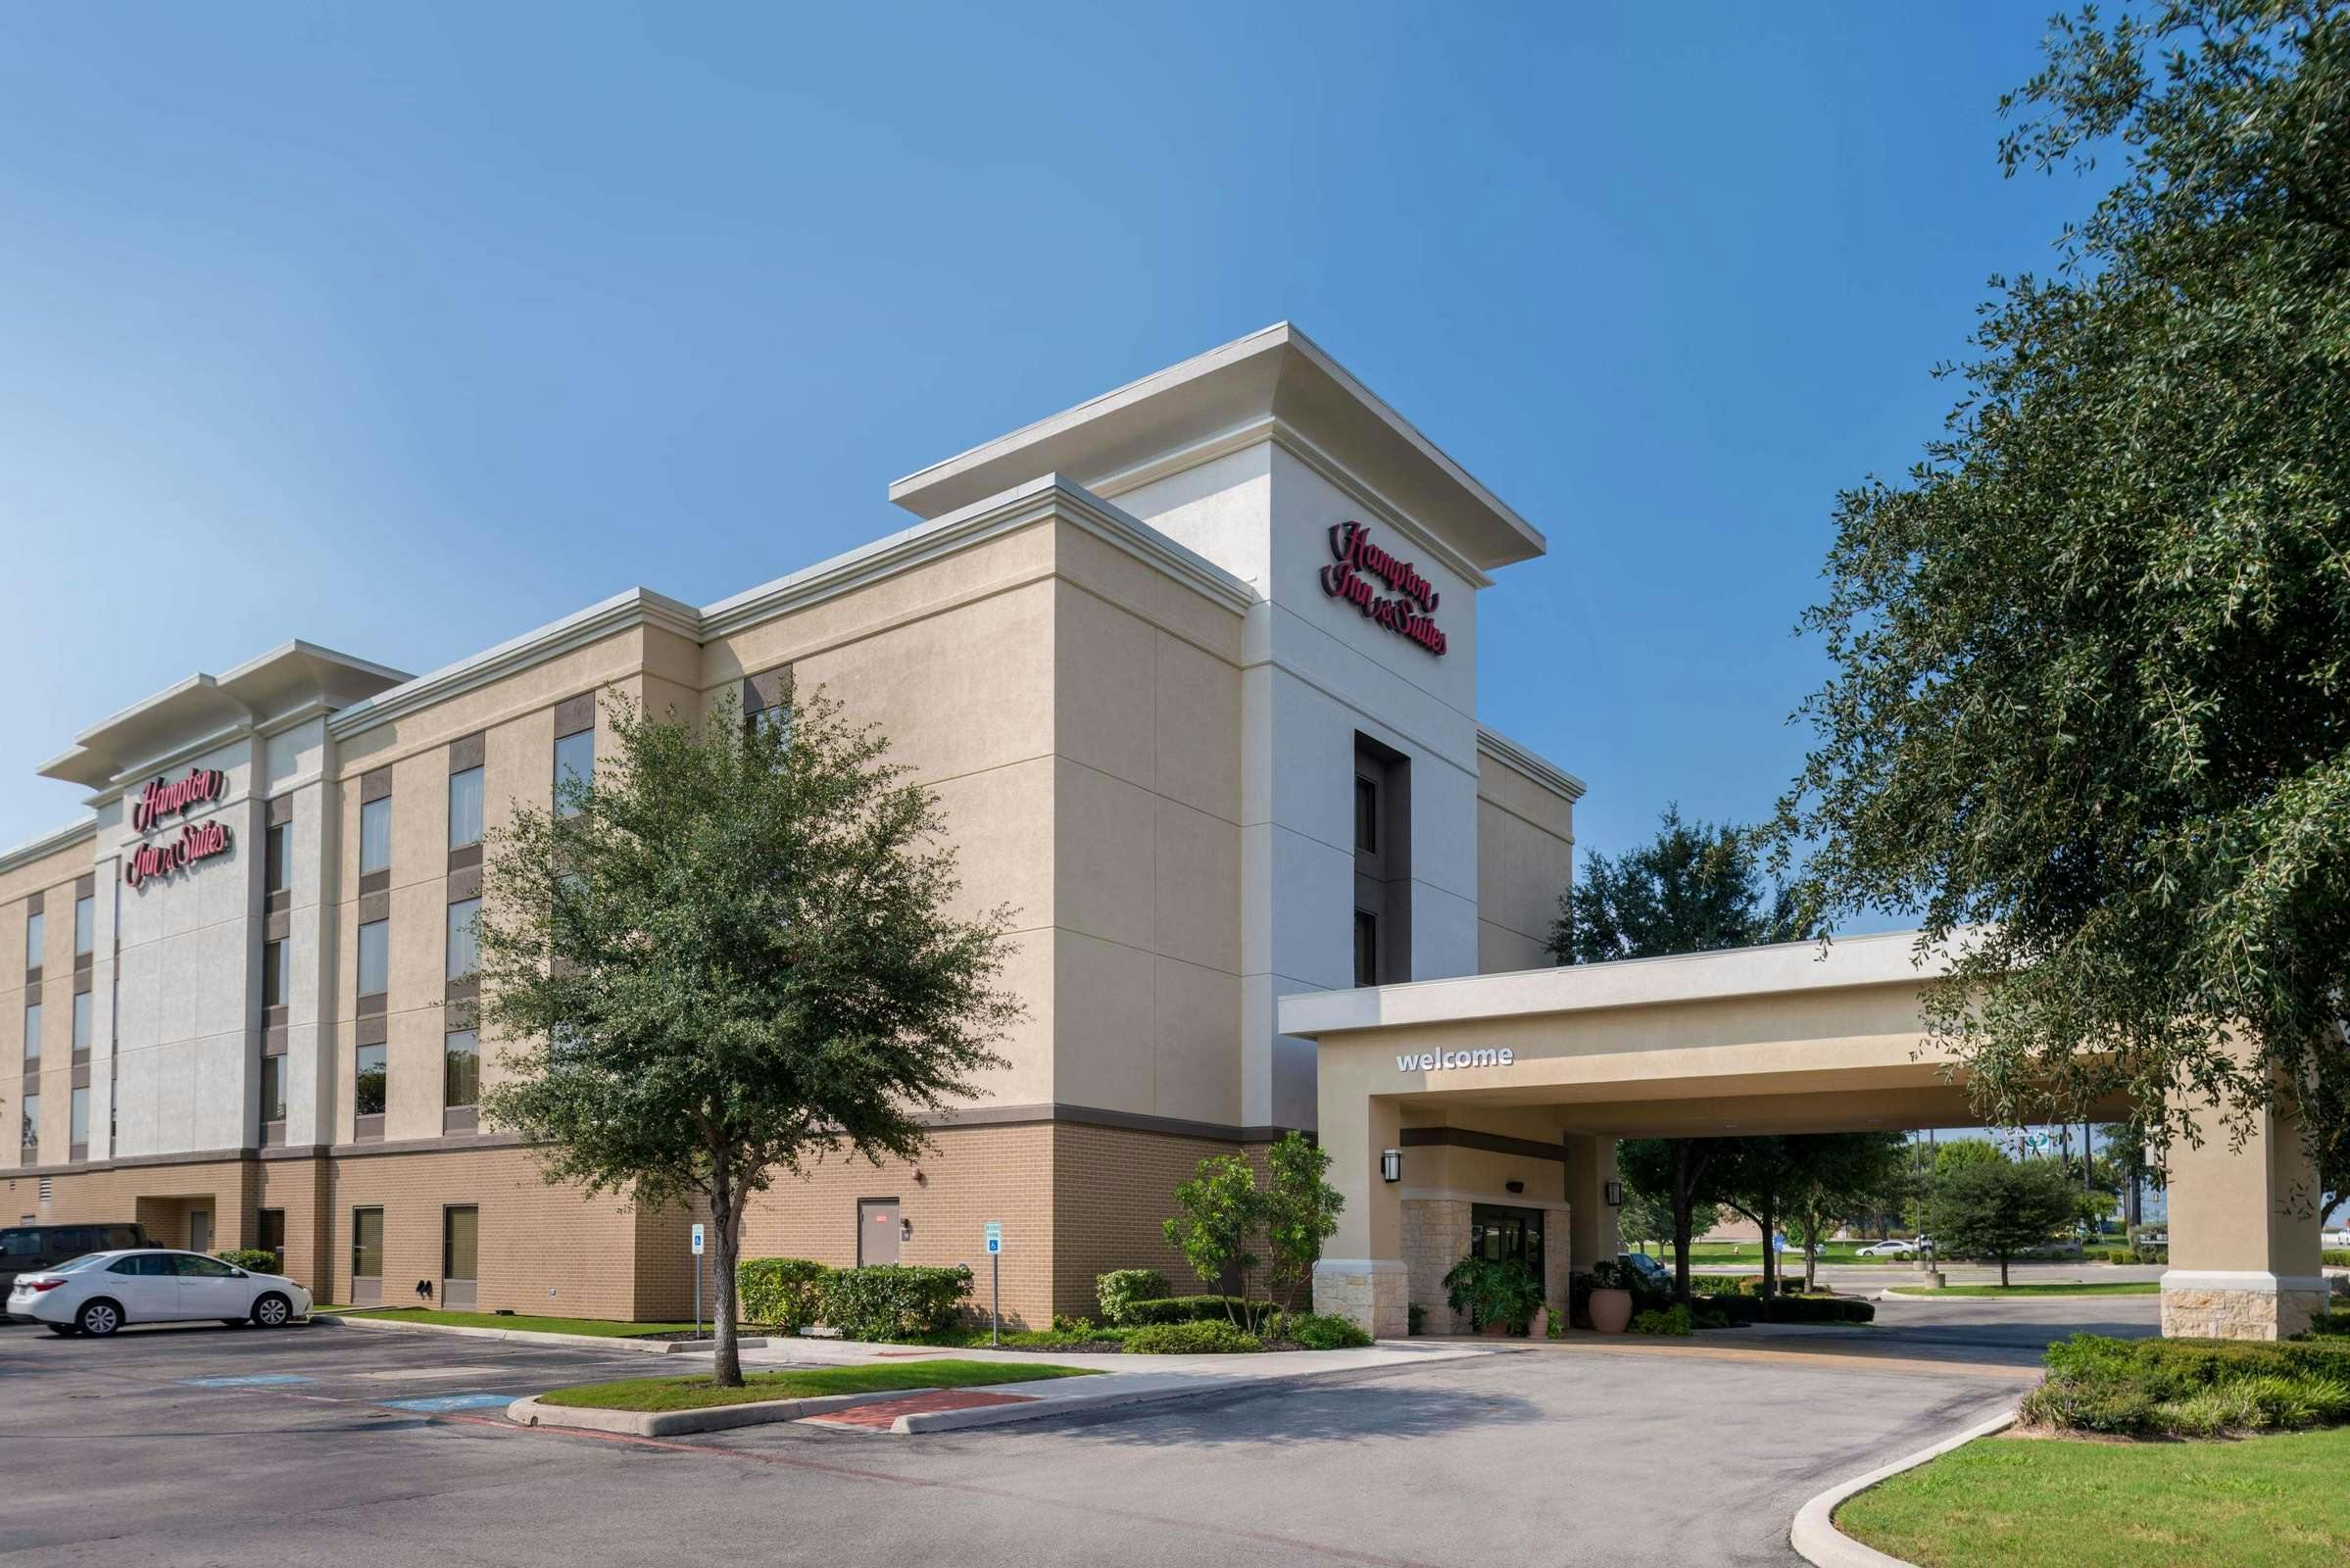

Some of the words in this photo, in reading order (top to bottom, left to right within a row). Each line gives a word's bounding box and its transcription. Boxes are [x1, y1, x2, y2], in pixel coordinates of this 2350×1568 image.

[1328, 520, 1440, 612] Hampton
[1320, 563, 1382, 618] Inn
[1394, 597, 1447, 656] Suites
[133, 767, 224, 833] Hampton
[126, 843, 167, 888] Inn
[176, 819, 229, 865] Suites
[1395, 1046, 1514, 1072] welcome
